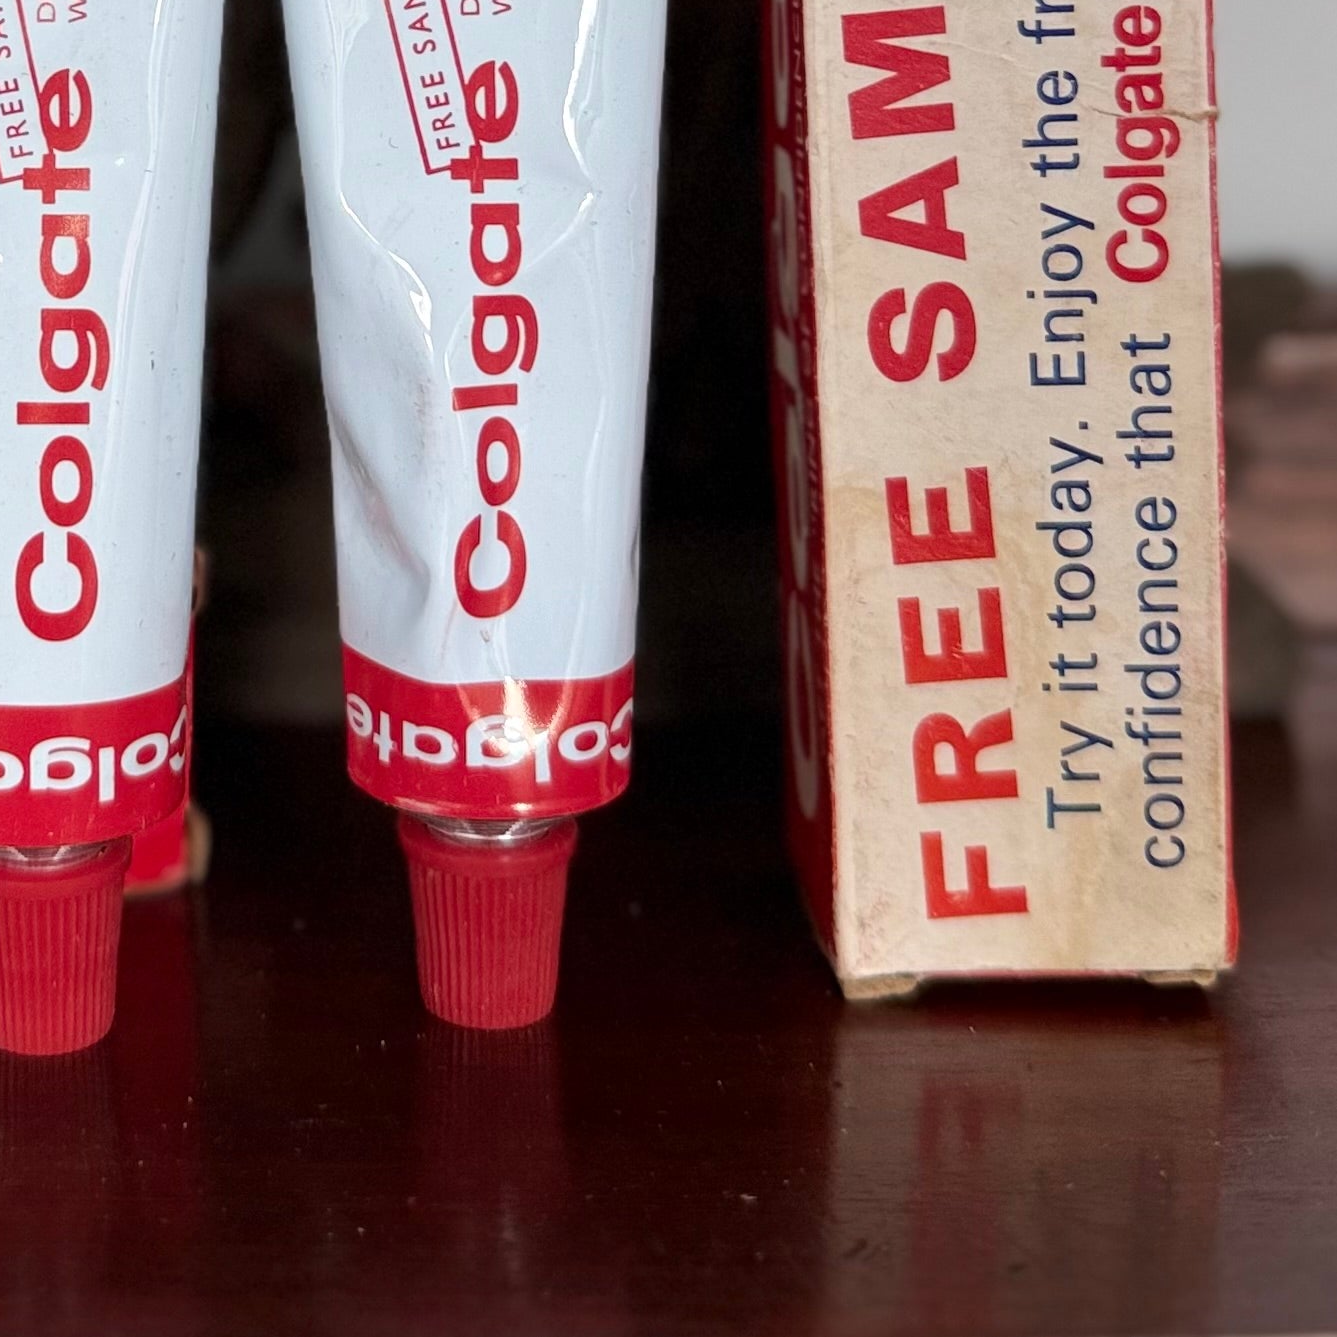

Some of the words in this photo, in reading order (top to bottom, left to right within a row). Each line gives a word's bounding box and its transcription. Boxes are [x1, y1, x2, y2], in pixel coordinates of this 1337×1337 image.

[420, 70, 461, 151] FREE
[1022, 70, 1078, 177] the
[1100, 4, 1181, 283] Colgate
[15, 68, 110, 642] Colgate
[451, 60, 539, 619] Colgate
[1026, 201, 1097, 386] Enjoy
[1116, 332, 1173, 469] that
[1036, 420, 1104, 628] today.
[886, 467, 1028, 919] FREE
[1042, 651, 1098, 692] it
[1125, 496, 1185, 869] confidence
[1045, 720, 1113, 829] Try
